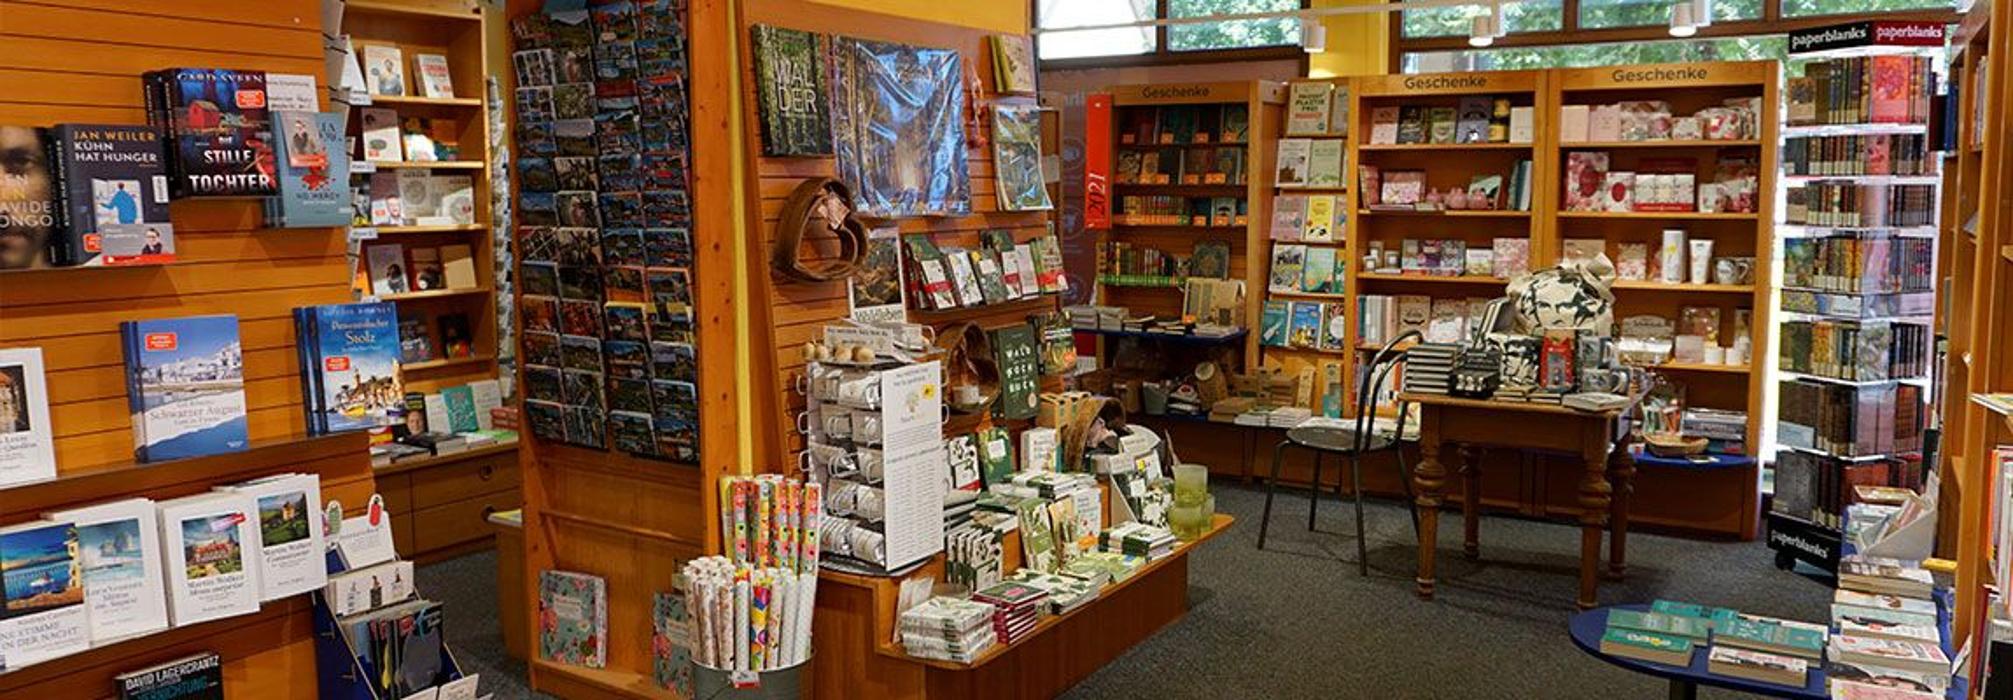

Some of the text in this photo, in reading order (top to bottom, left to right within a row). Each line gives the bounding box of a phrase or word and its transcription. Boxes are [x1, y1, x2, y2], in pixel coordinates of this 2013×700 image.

[1791, 25, 1867, 49] paperblanks
[1876, 24, 1942, 41] paperblanks
[1404, 74, 1487, 90] Geschenke
[1612, 68, 1708, 83] Geschenke
[778, 87, 817, 113] DER
[1142, 86, 1210, 98] Geschenke
[74, 131, 156, 142] JAN WEILER
[73, 140, 114, 151] KÜHN
[75, 152, 157, 163] HAT HUNGER
[204, 150, 251, 163] STILLE
[189, 174, 270, 192] TOCHTER
[1088, 172, 1106, 215] 2021
[1771, 531, 1828, 559] paperblanks
[42, 626, 80, 642] NACHT
[125, 655, 219, 690] DAVID LAGERCRANTZ
